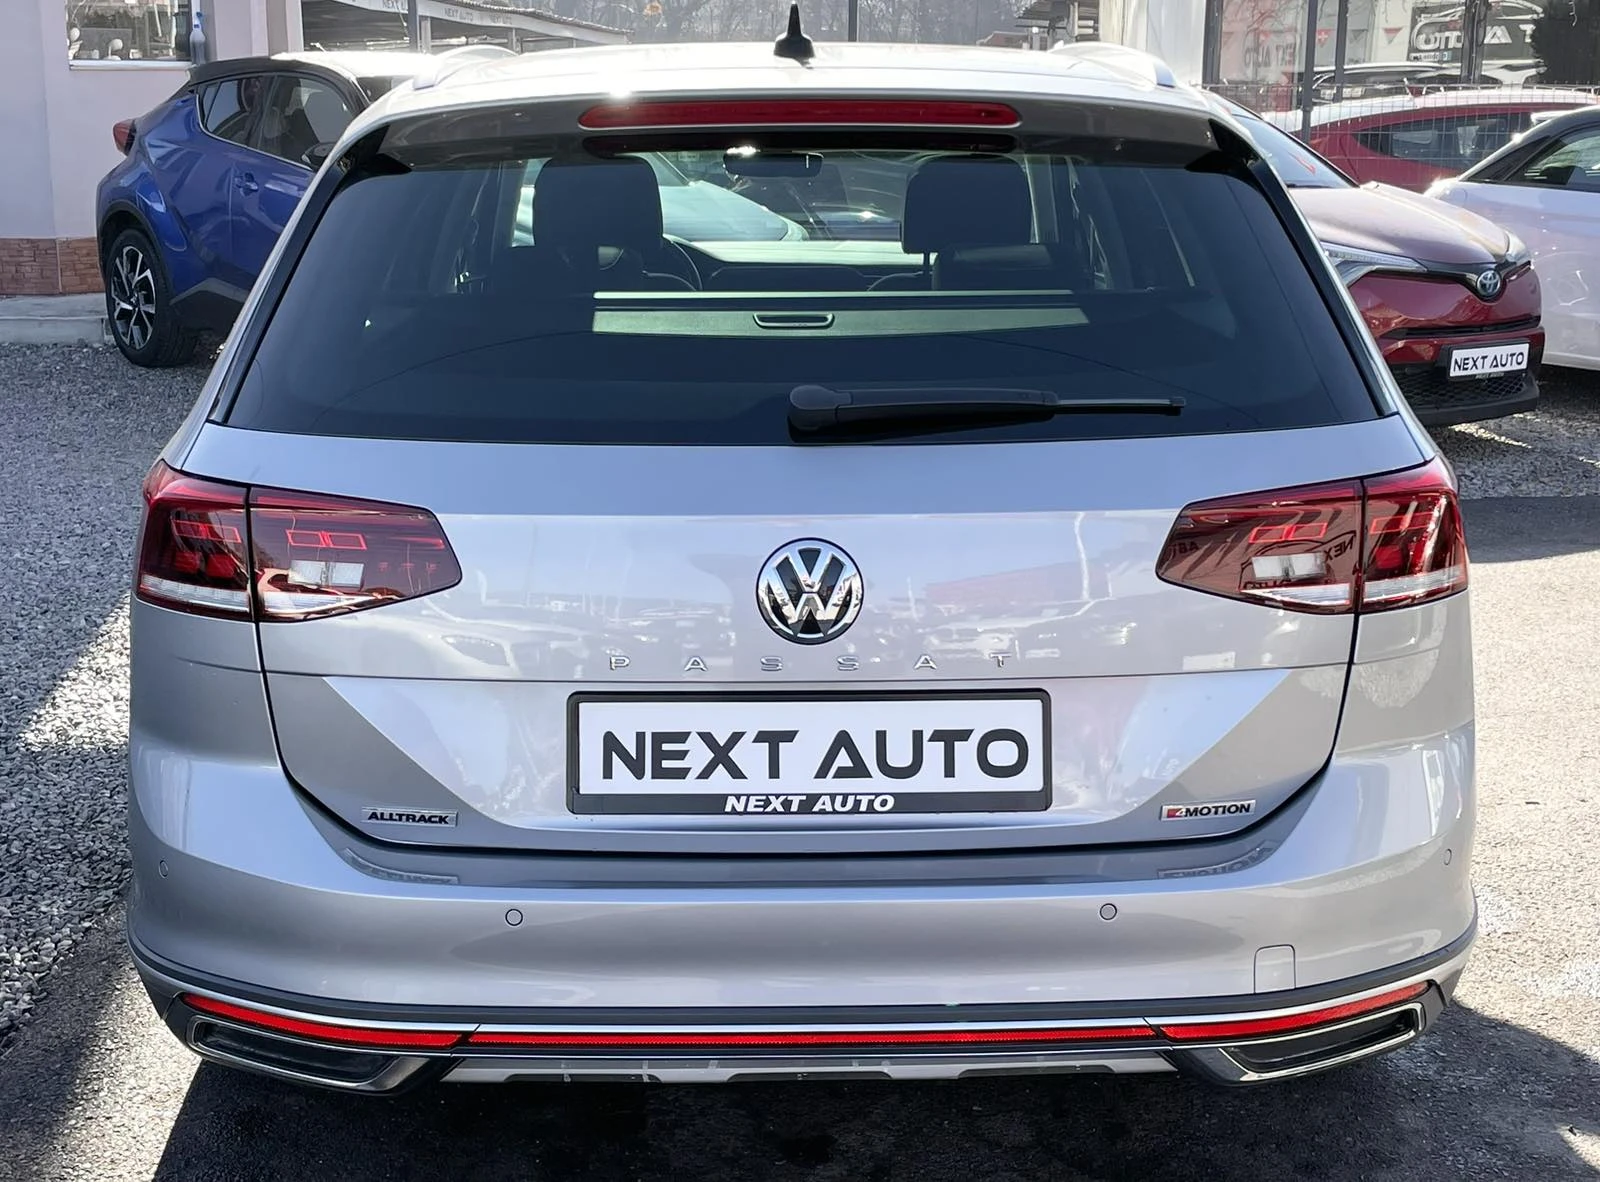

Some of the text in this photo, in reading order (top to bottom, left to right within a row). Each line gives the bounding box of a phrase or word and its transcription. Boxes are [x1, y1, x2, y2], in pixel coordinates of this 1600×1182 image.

[1453, 351, 1525, 372] NEXT AUTO
[608, 652, 1013, 672] PASSAT
[602, 728, 1029, 780] NEXT AUTO
[724, 794, 895, 812] NEXT AUTO
[1174, 803, 1251, 818] 4MOTION
[367, 811, 449, 824] ALLTRACK
